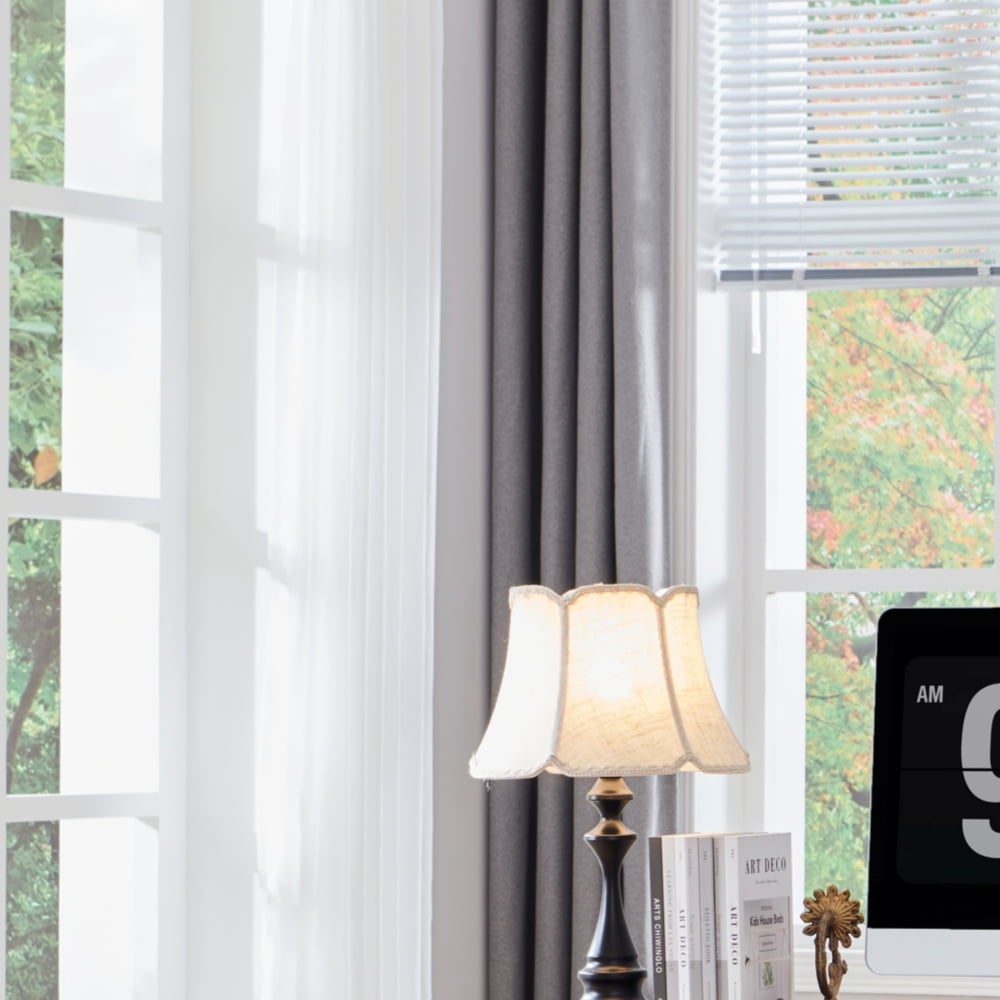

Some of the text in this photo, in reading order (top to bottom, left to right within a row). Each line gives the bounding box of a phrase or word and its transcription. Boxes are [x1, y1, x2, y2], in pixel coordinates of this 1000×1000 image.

[917, 685, 944, 703] AM
[745, 856, 787, 875] ART DECO
[653, 897, 662, 921] ARTS
[730, 906, 738, 926] ART
[731, 933, 739, 966] DECO
